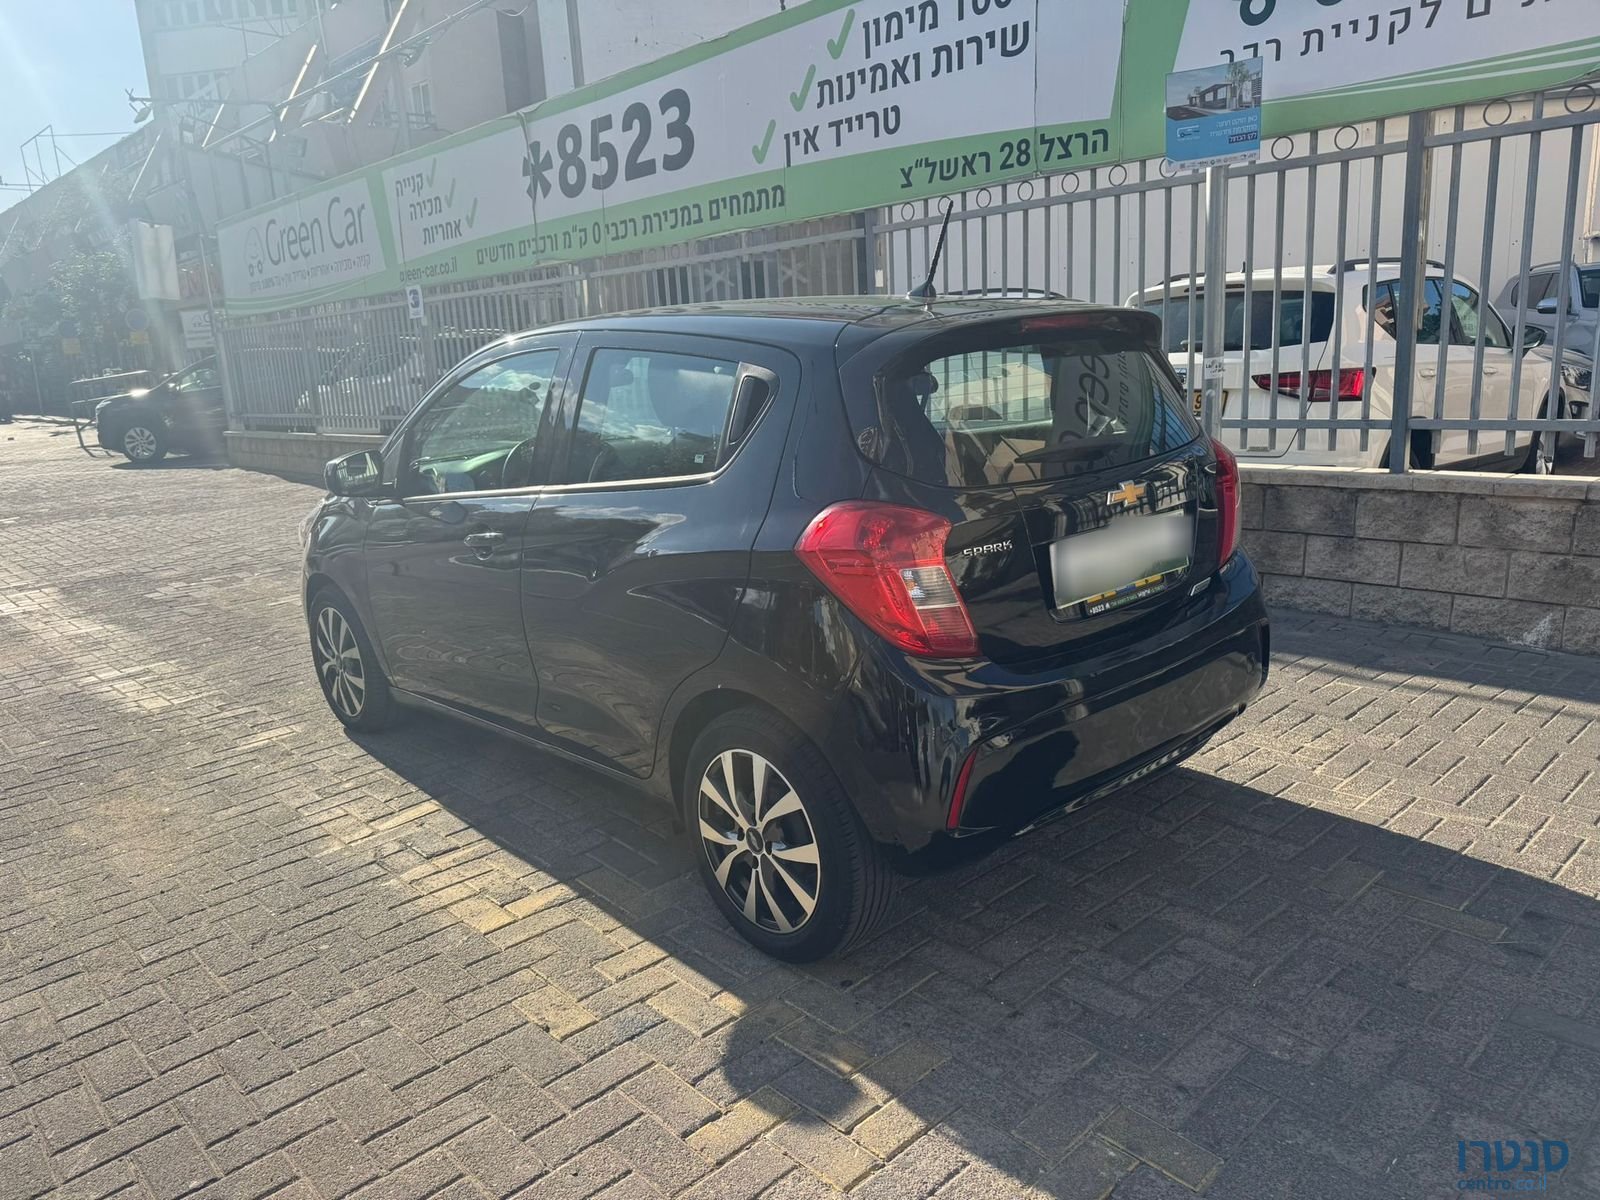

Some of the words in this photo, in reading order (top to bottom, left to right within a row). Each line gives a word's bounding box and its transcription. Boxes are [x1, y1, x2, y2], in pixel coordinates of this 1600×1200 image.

[862, 0, 939, 59] מימון
[1300, 0, 1442, 57] לקניית
[931, 20, 1030, 78] שירות
[816, 52, 921, 109] ואמינות
[828, 105, 901, 148] טרייד
[784, 125, 820, 168] אין
[999, 138, 1031, 171] 28
[1039, 128, 1109, 162] הרצל
[395, 173, 424, 198] קנייה
[409, 196, 443, 221] מכירה
[641, 203, 704, 235] במכירת
[708, 184, 785, 221] מתמחים
[265, 217, 325, 266] Green
[327, 196, 366, 249] Car
[423, 219, 463, 245] אחריות
[518, 233, 559, 257] ורכבים
[592, 221, 601, 244] 0
[604, 217, 637, 241] רכבי
[476, 242, 515, 265] חדשים
[963, 539, 1013, 557] SPARK
